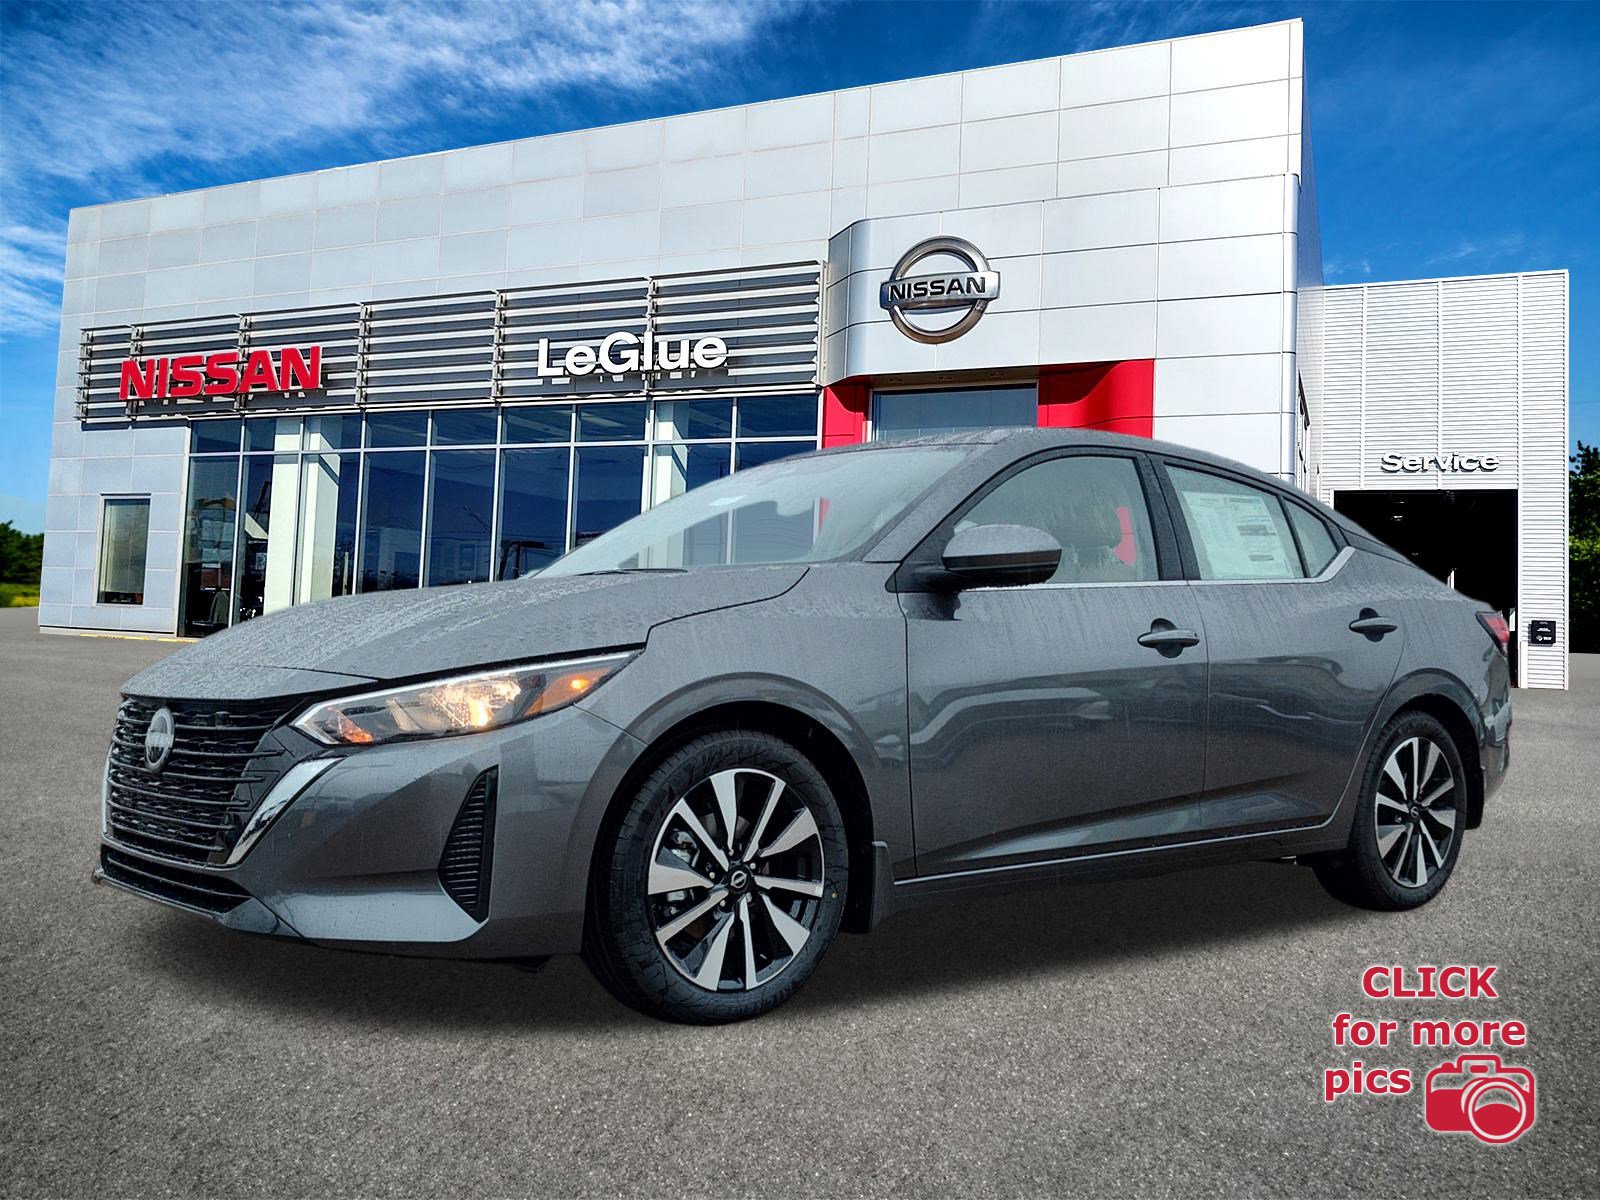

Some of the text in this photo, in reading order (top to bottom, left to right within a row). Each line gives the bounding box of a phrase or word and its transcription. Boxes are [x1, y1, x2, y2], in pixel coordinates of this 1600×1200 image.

[888, 277, 986, 301] NISSAN
[537, 331, 728, 377] LeGlue
[119, 346, 322, 400] NISSAN
[1381, 451, 1500, 473] Service
